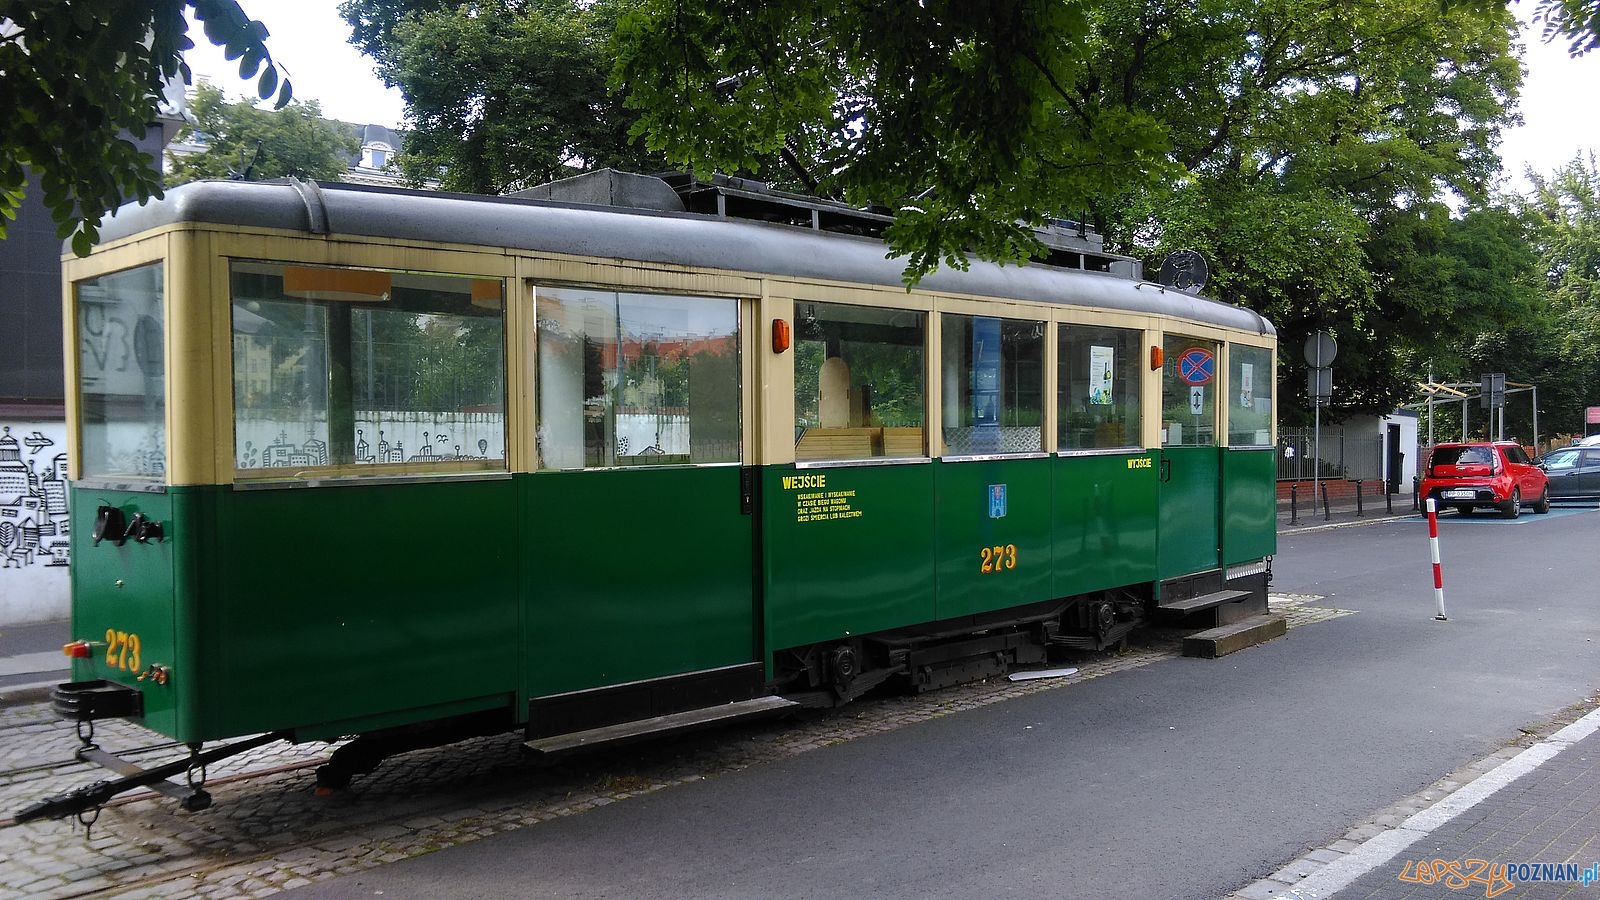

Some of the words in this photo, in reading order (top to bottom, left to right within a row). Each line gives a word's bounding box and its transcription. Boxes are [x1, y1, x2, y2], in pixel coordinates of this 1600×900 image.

[1127, 457, 1151, 468] WYJŚCIE
[782, 473, 825, 489] WEJŚCIE
[981, 544, 1017, 573] 273
[105, 628, 141, 674] 273
